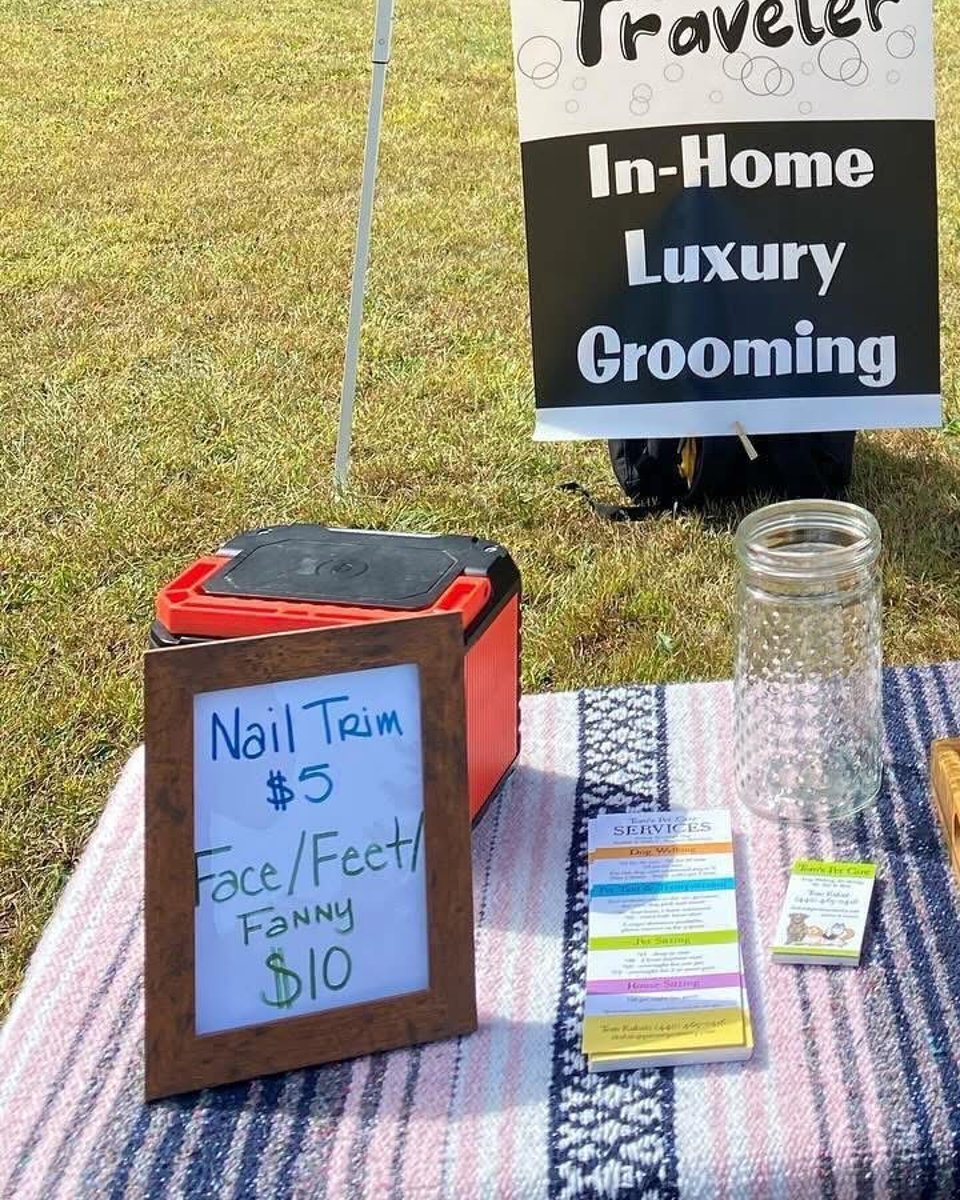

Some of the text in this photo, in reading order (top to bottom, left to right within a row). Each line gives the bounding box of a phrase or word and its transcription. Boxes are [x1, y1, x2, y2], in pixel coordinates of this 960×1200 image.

[588, 134, 875, 198] In-Home
[624, 228, 846, 297] Luxury
[577, 319, 896, 388] Grooming
[211, 701, 295, 761] Nail
[266, 764, 334, 811] $5
[613, 822, 713, 836] SERVICES
[260, 946, 353, 1009] $10
